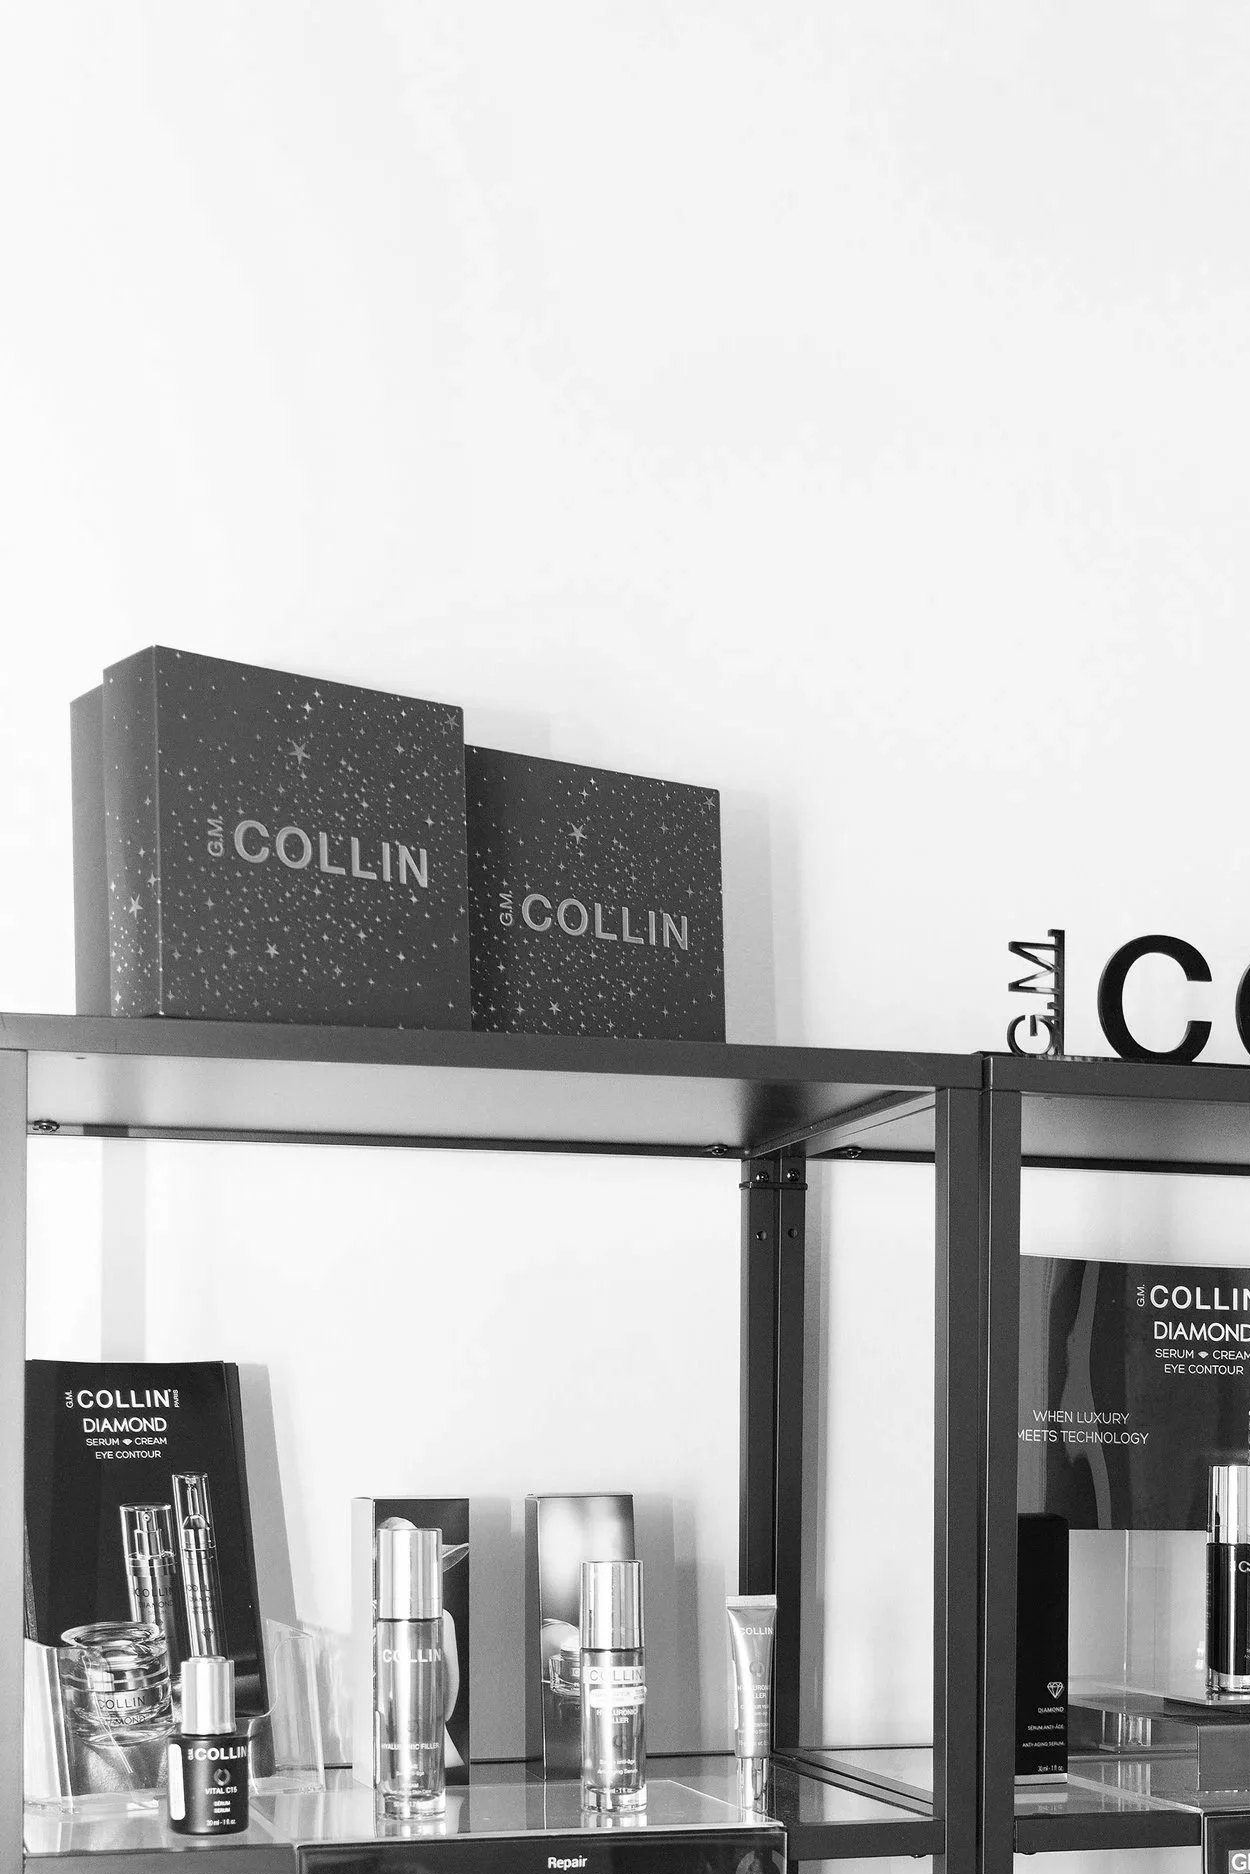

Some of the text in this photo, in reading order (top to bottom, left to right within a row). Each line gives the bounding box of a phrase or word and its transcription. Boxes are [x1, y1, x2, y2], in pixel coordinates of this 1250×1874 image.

[234, 820, 429, 889] COLLIN
[521, 894, 688, 950] COLLIN
[1155, 1349, 1194, 1359] SERUM
[1164, 1365, 1244, 1375] EYE CONTOUR
[77, 1390, 169, 1408] COLLIN
[1033, 1409, 1130, 1424] WHEN LUXURY
[83, 1416, 167, 1433] DIAMOND
[86, 1436, 167, 1446] SERUM CREAM
[1060, 1430, 1148, 1444] TECHNOLOGY
[95, 1450, 161, 1459] EYE CONTOUR
[195, 1746, 247, 1760] COLLIN
[548, 1857, 587, 1869] Repair
